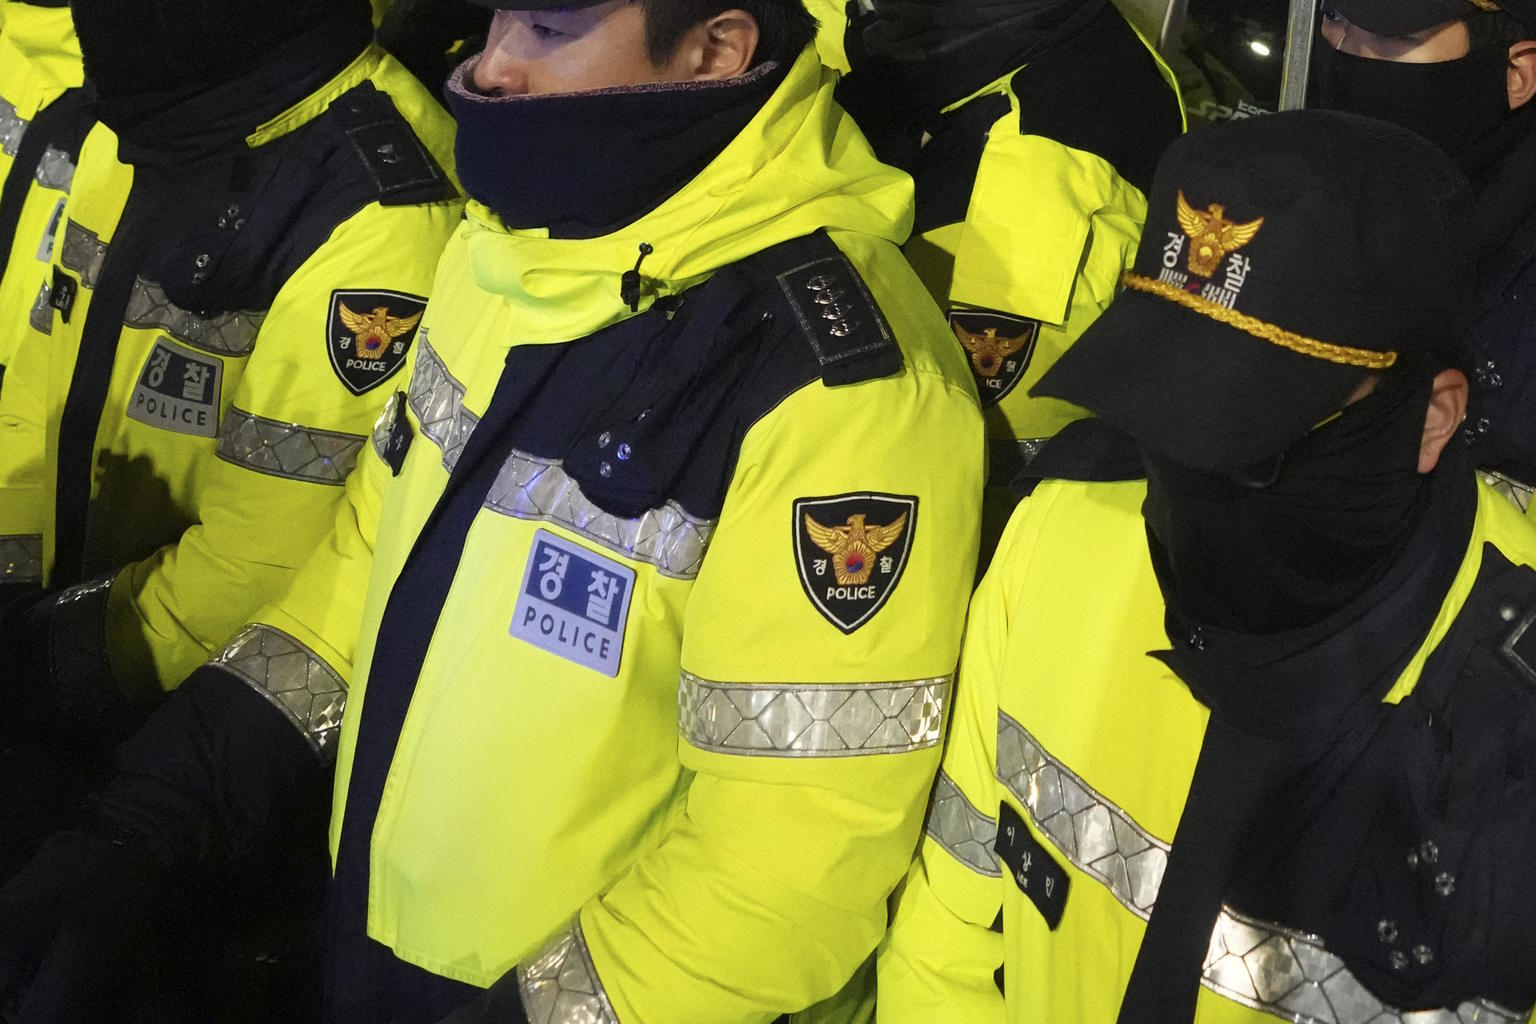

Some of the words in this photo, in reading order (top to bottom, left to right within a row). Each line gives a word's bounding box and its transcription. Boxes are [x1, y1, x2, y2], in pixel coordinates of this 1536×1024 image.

[1163, 232, 1185, 268] 경
[1224, 253, 1251, 293] 찰
[345, 358, 387, 372] POLICE
[136, 392, 207, 426] POLICE
[826, 585, 877, 601] POLICE
[523, 605, 610, 660] POLICE
